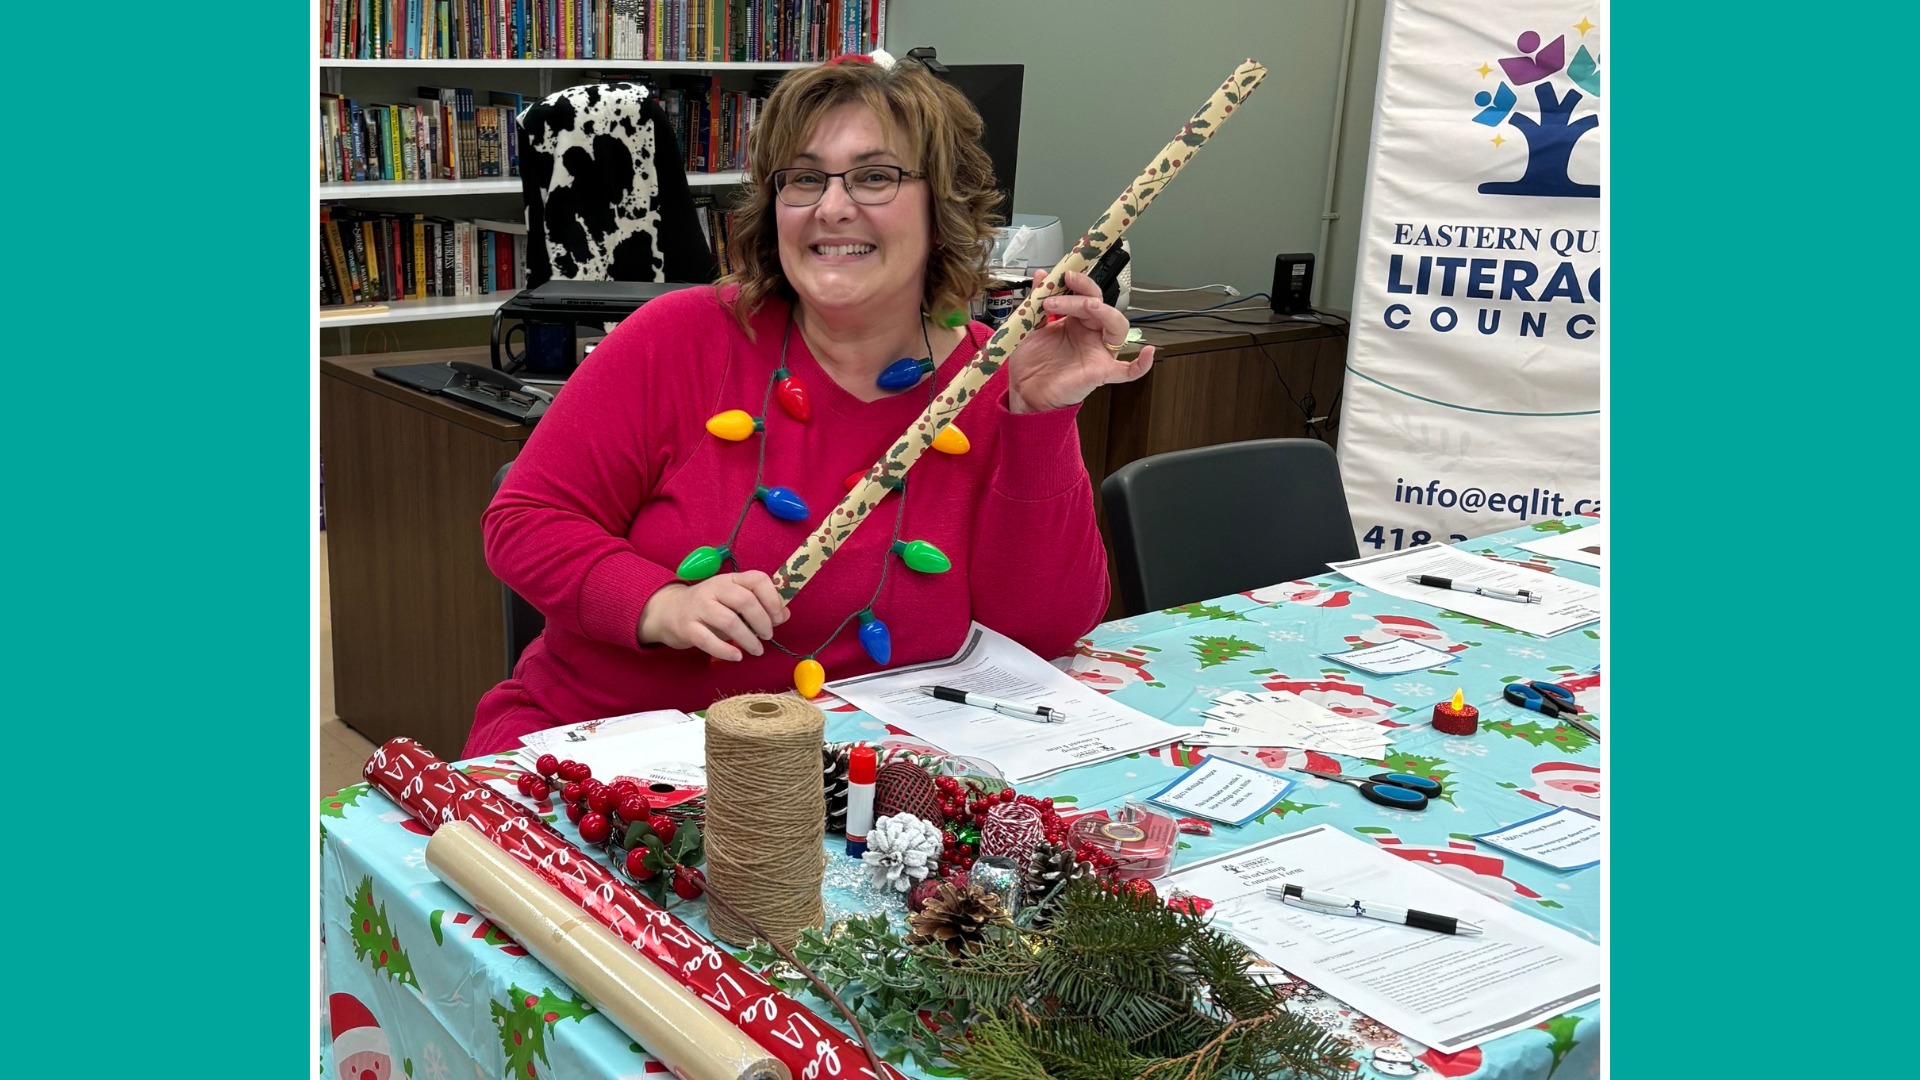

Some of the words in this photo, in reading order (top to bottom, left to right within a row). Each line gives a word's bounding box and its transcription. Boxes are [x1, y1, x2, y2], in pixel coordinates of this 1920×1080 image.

[354, 136, 362, 157] school
[444, 230, 455, 269] POWERLESS
[1392, 223, 1542, 251] EASTERN
[1550, 229, 1600, 257] QU
[384, 754, 415, 780] LA
[1199, 769, 1217, 782] Prompts
[434, 773, 470, 794] LA
[509, 831, 545, 860] LA
[562, 860, 602, 884] LA
[1239, 865, 1286, 880] Workshop
[1243, 873, 1280, 887] Consent
[1278, 867, 1305, 878] Form
[661, 925, 707, 949] LA
[702, 972, 746, 1011] LA
[771, 1012, 821, 1049] LA
